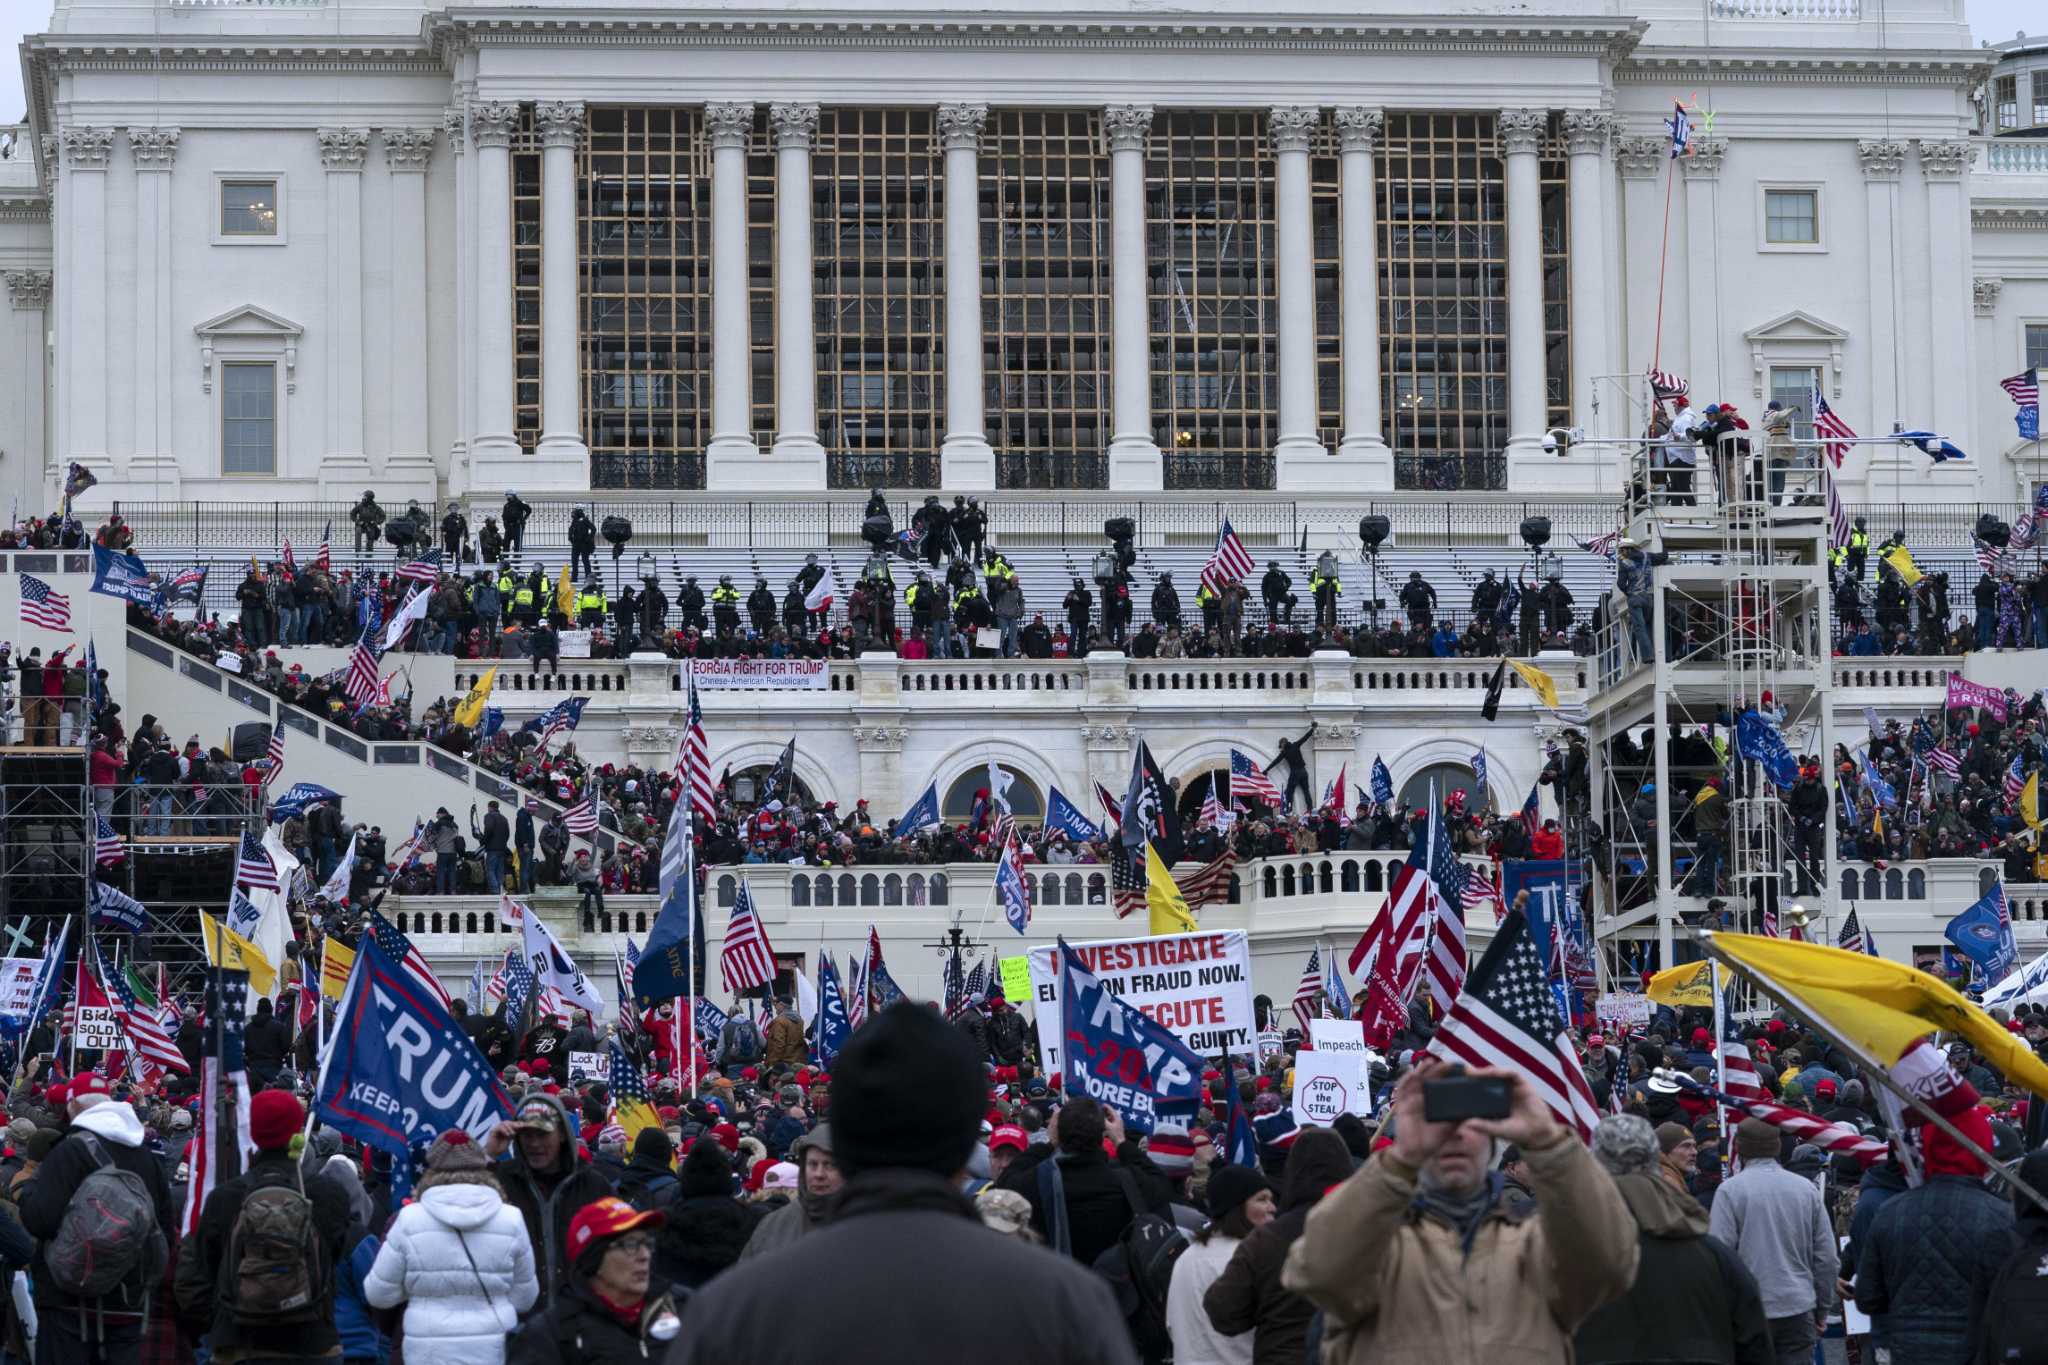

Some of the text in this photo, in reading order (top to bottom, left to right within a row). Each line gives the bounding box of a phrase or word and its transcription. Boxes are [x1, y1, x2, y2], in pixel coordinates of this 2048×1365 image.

[733, 662, 763, 675] FIGHT
[765, 662, 788, 675] FOR
[790, 662, 824, 675] TRUMP
[700, 676, 810, 686] Chinese-American Republicans
[1050, 933, 1227, 977] IVESTIGATE
[1132, 970, 1193, 994] FRAUD
[1198, 963, 1246, 987] NOW.
[79, 1024, 114, 1036] SOLD
[86, 1035, 123, 1049] OUT
[1318, 1039, 1363, 1053] Impeach
[1312, 1081, 1337, 1092] STOP
[350, 1081, 400, 1116] KEEP
[1316, 1093, 1332, 1103] the
[1308, 1104, 1338, 1115] STEAL
